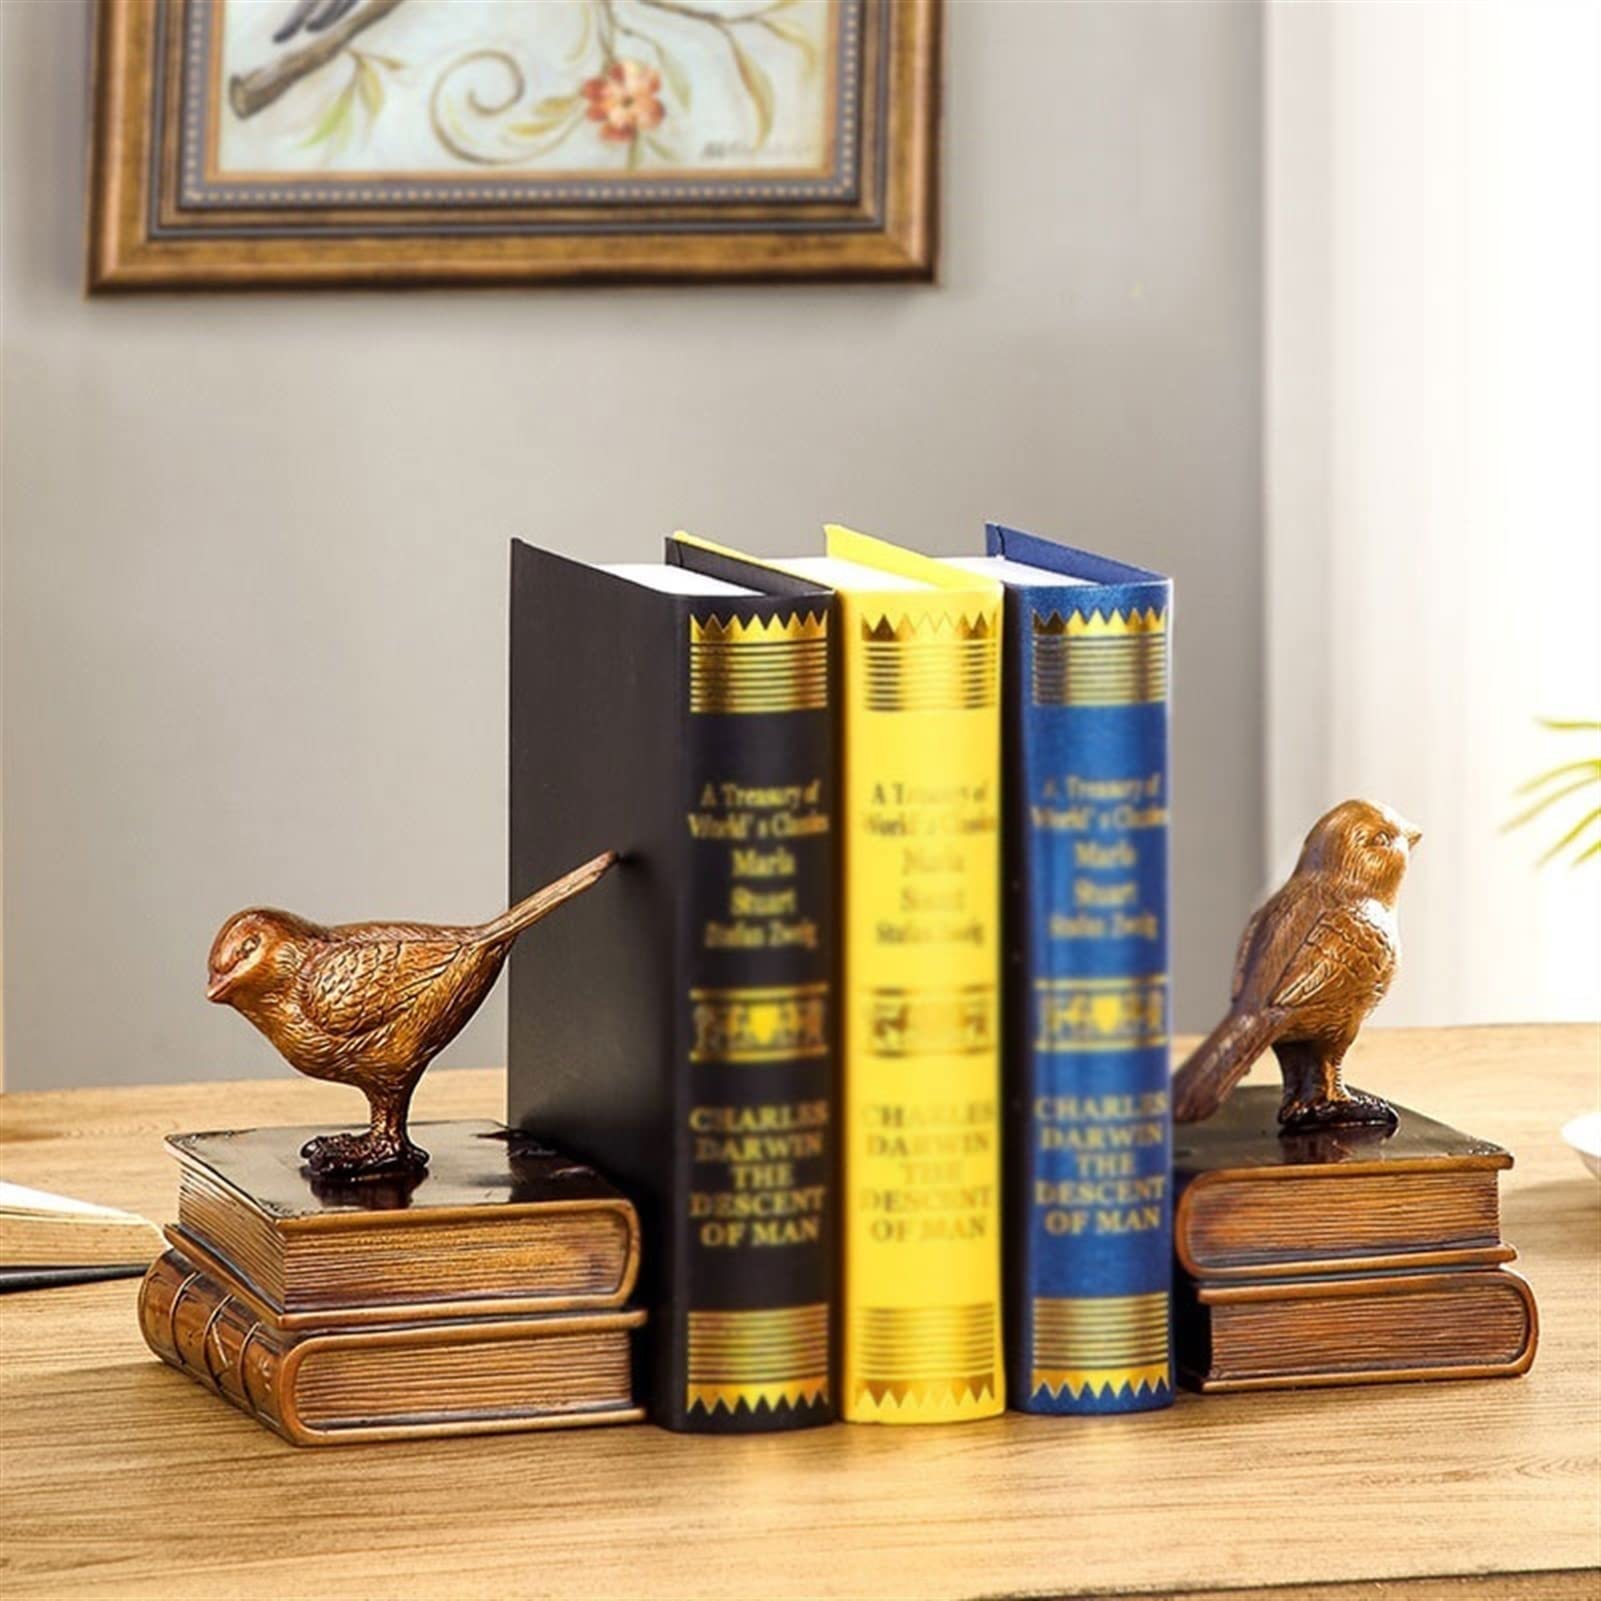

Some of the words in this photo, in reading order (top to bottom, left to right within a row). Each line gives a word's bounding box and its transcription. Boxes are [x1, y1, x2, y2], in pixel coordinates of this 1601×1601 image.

[689, 1101, 828, 1133] CHARLES
[1034, 1092, 1168, 1122] CHARLES
[696, 1133, 823, 1162] DARWIN
[1041, 1122, 1164, 1149] DARWIN
[731, 1162, 792, 1189] THE
[1073, 1152, 1135, 1177] THE
[689, 1187, 825, 1217] DESCENT
[1034, 1175, 1166, 1205] DESCENT
[701, 1222, 744, 1247] OF
[751, 1216, 819, 1246] MAN
[1044, 1210, 1087, 1236] OF
[1096, 1206, 1161, 1236] MAN
